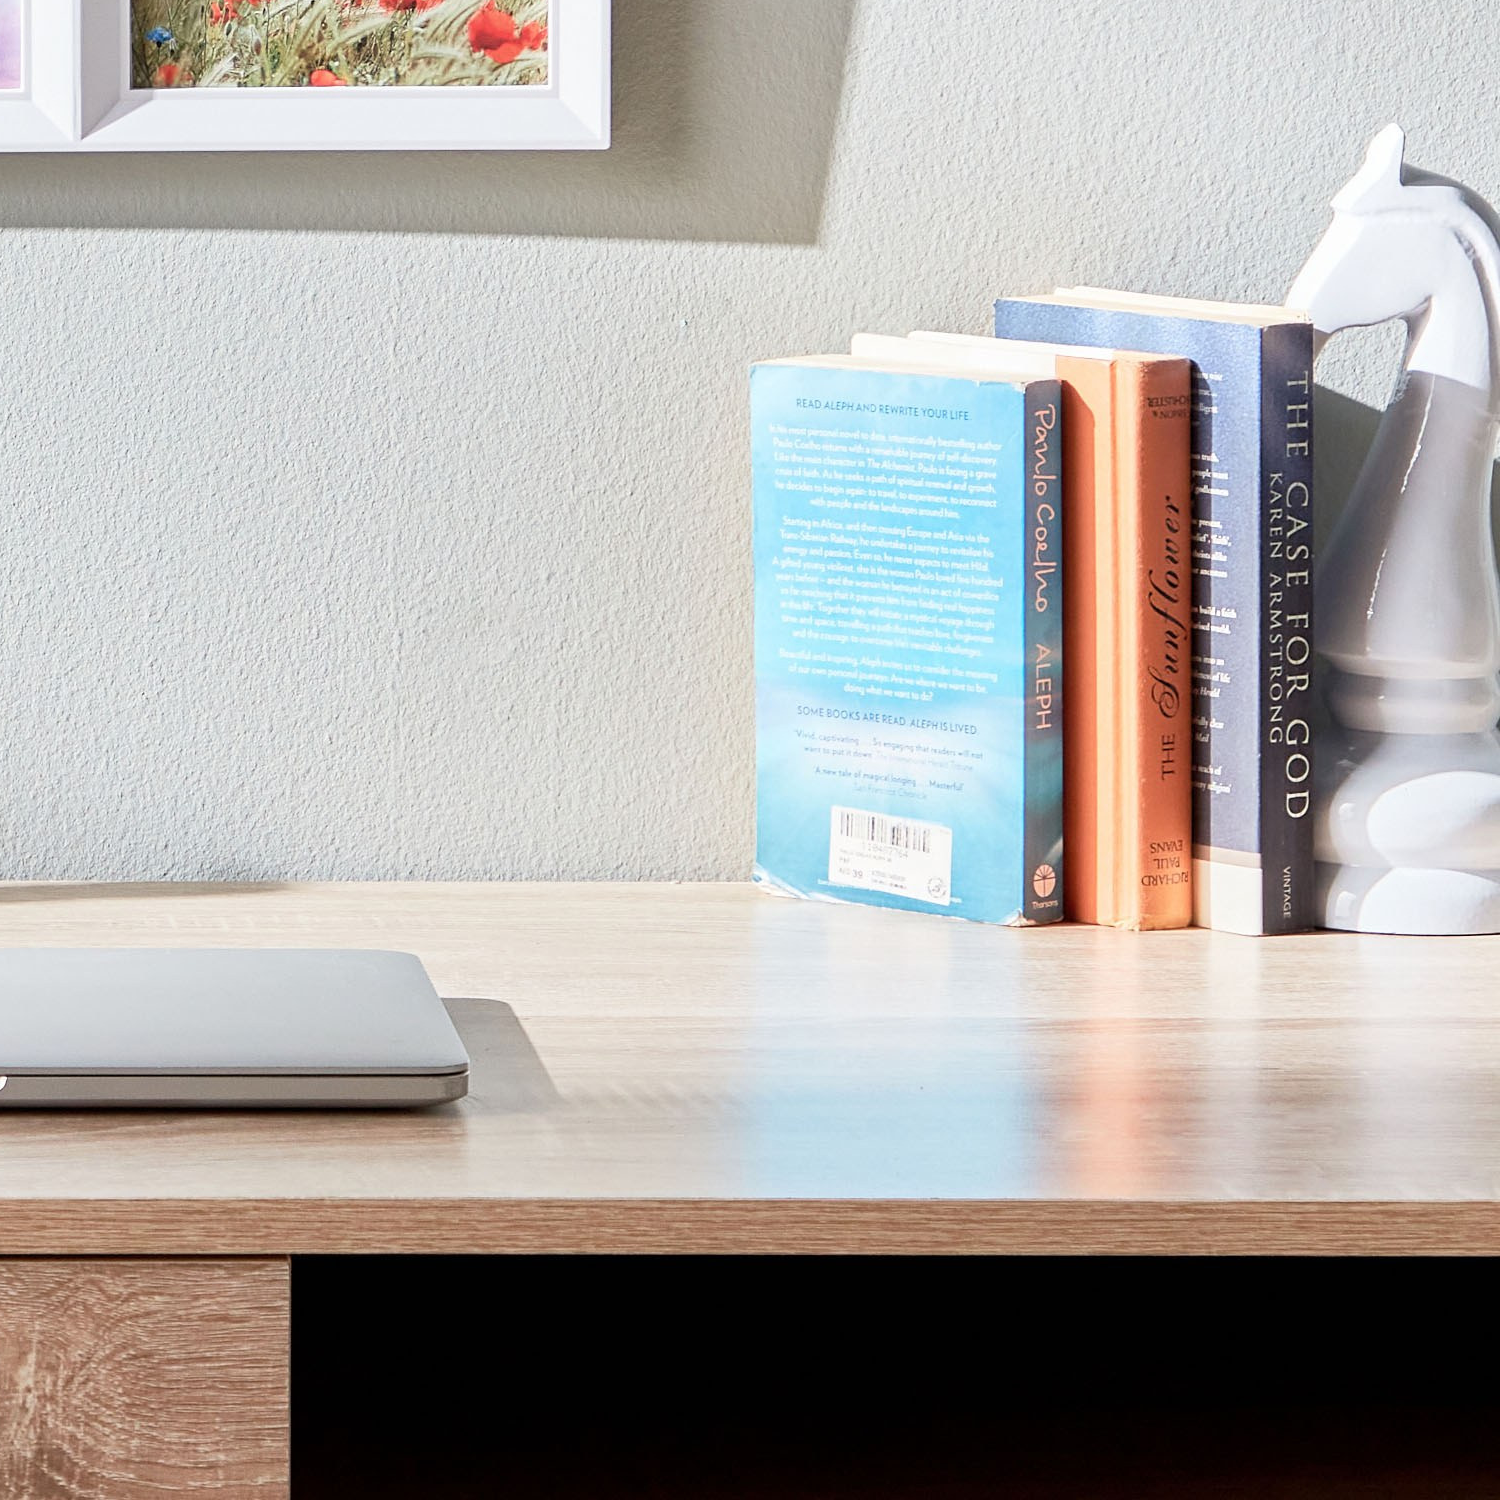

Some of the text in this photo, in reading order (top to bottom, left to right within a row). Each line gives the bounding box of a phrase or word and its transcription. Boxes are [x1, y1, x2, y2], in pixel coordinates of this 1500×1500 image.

[796, 398, 821, 409] READ
[824, 400, 854, 412] ALEPH
[856, 402, 876, 413] AND
[879, 404, 918, 417] REWRITE
[921, 407, 947, 419] YOUR
[1033, 404, 1057, 613] Paulo Coelho
[1269, 472, 1283, 744] KAREN ARMSTRONG
[1286, 371, 1310, 818] THE CASE FOR GOD
[1148, 495, 1188, 780] THE Sunflower
[1036, 644, 1052, 730] ALEPH
[797, 703, 824, 717] SOME
[827, 707, 860, 722] BOOKS
[862, 711, 880, 724] ARE
[909, 717, 938, 731] ALEPH
[940, 721, 947, 733] IS
[1150, 840, 1183, 854] EVANS
[1153, 856, 1180, 869] PAUL
[1141, 871, 1189, 887] RICHARD
[1283, 866, 1292, 918] VINTAGE
